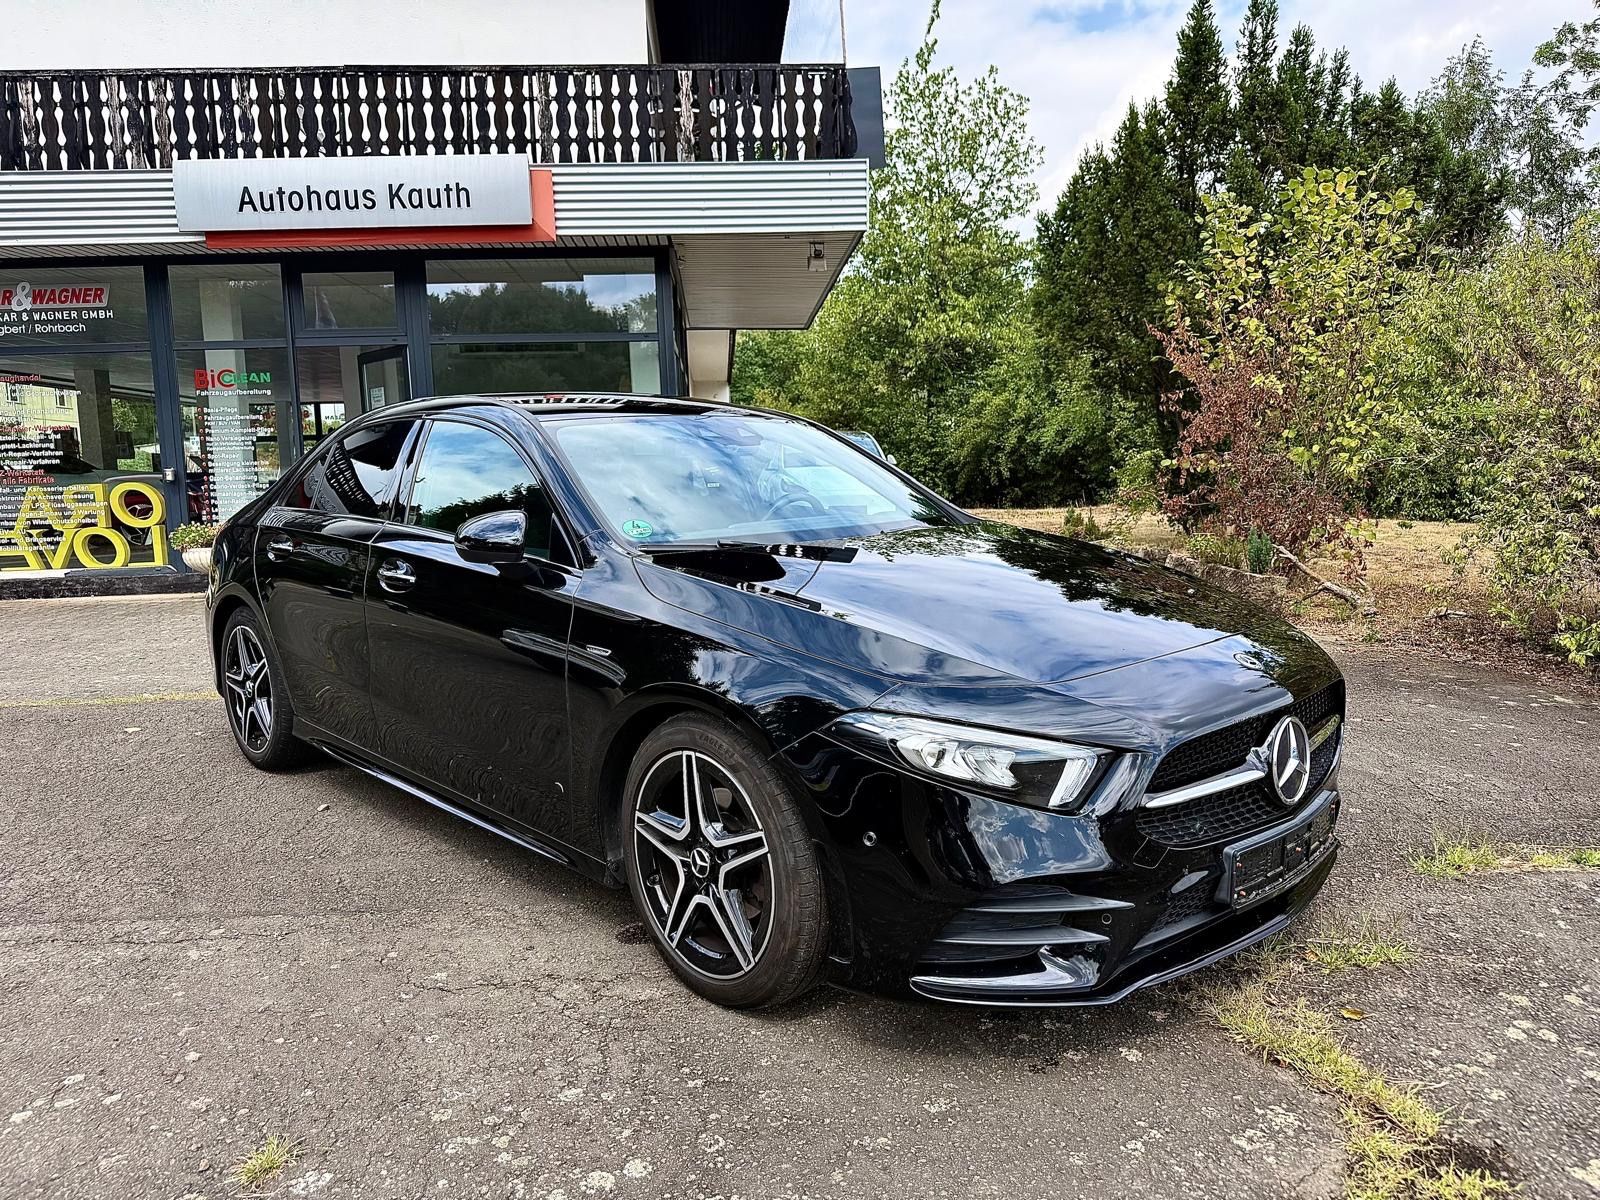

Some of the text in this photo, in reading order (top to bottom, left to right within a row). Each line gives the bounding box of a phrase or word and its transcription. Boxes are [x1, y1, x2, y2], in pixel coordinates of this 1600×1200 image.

[238, 182, 471, 213] Autohaus Kauth
[21, 312, 29, 321] &
[32, 310, 78, 321] WAGNER
[82, 309, 114, 319] GMBH
[34, 322, 87, 333] Rohrbach
[196, 388, 272, 396] Fahrzeugaufbereitung
[203, 413, 264, 421] Fahrzeugaufbereitung
